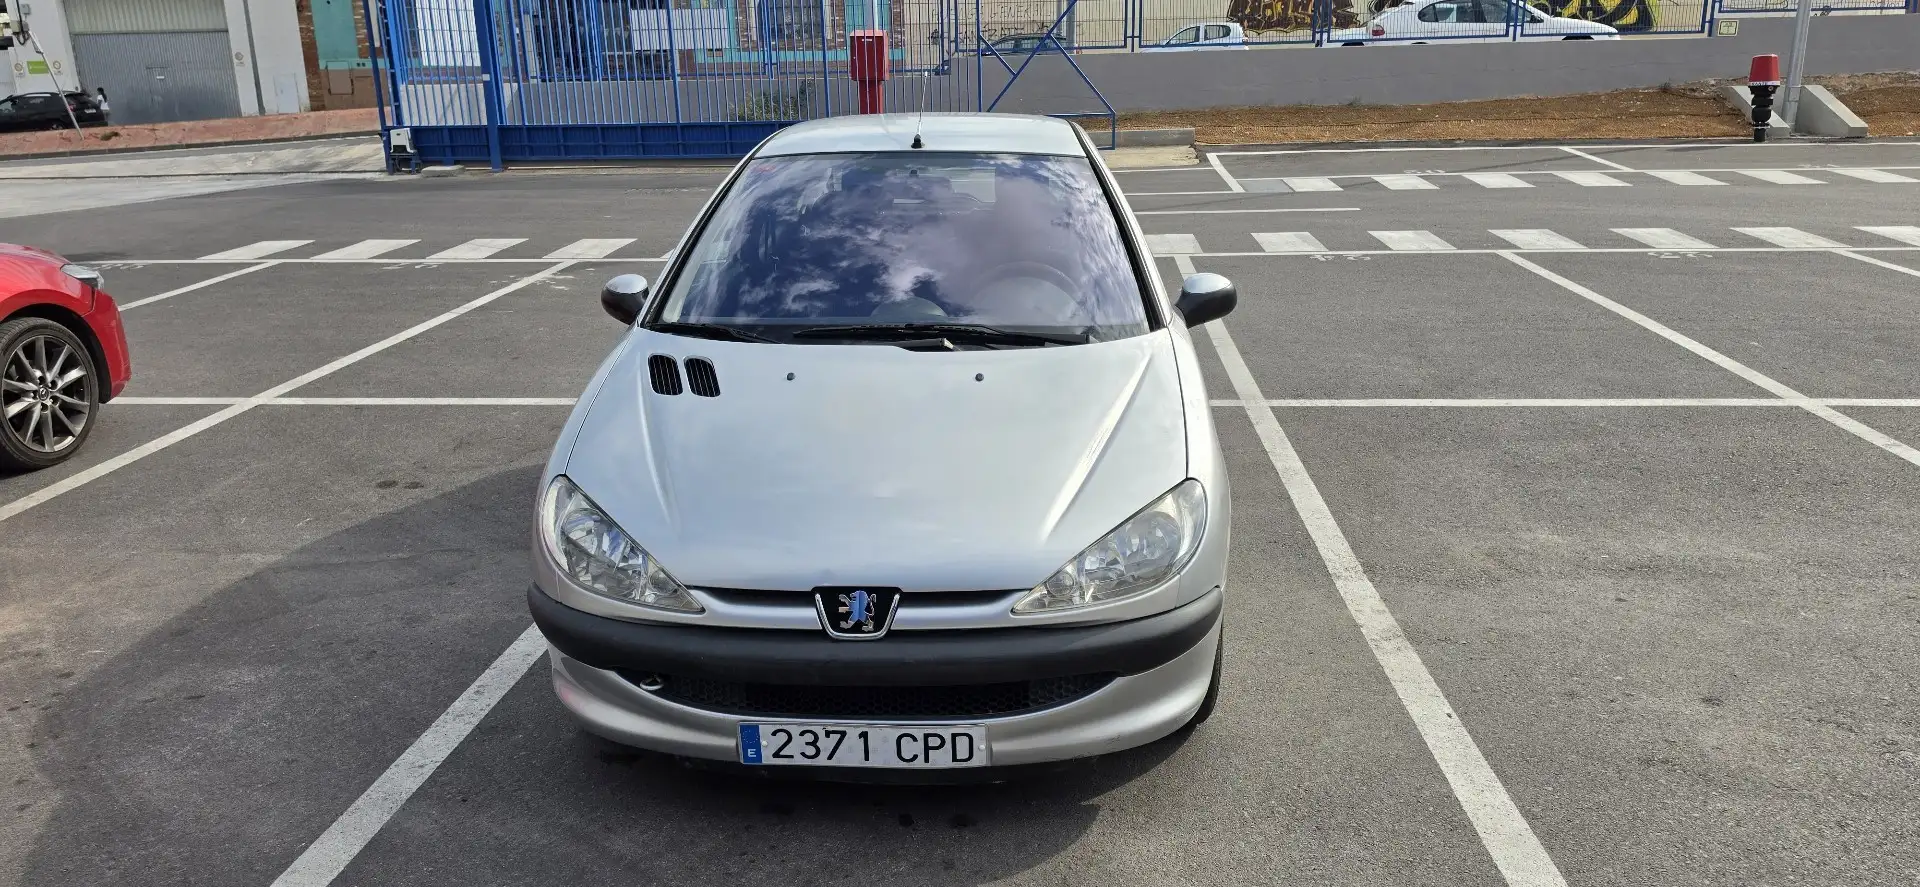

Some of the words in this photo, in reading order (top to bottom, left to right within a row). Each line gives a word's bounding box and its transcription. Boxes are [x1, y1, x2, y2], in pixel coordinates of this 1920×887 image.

[747, 748, 757, 757] E
[770, 728, 870, 761] 2371
[895, 732, 974, 763] CPD
